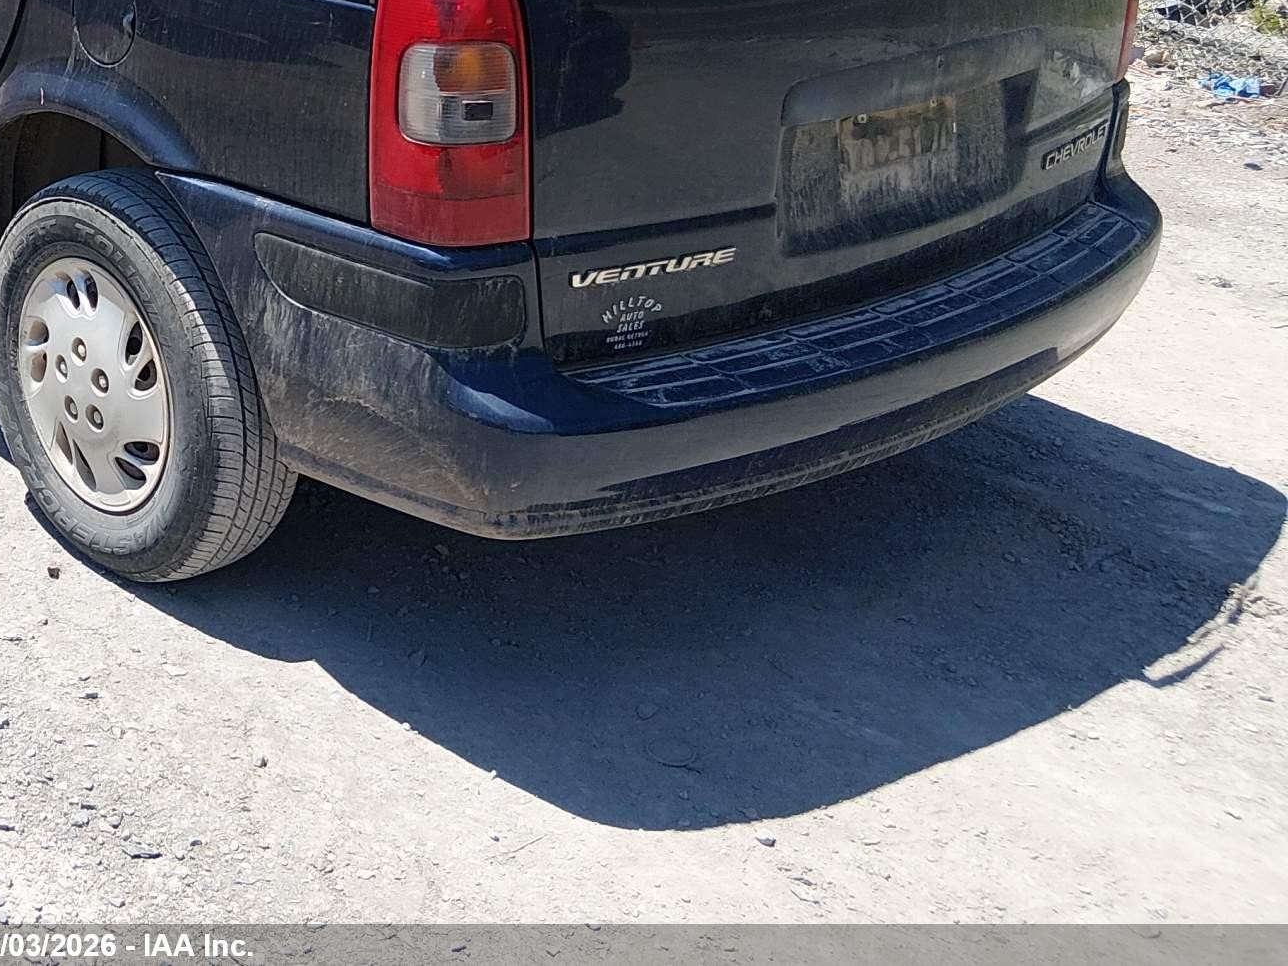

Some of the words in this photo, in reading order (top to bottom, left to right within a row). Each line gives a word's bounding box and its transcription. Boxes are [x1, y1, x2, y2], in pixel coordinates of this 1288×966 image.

[1045, 121, 1110, 170] CHEVROLET
[571, 247, 737, 289] VENTURE
[601, 295, 663, 324] HILLTOP
[619, 310, 644, 323] AUTO
[616, 320, 645, 334] SALES
